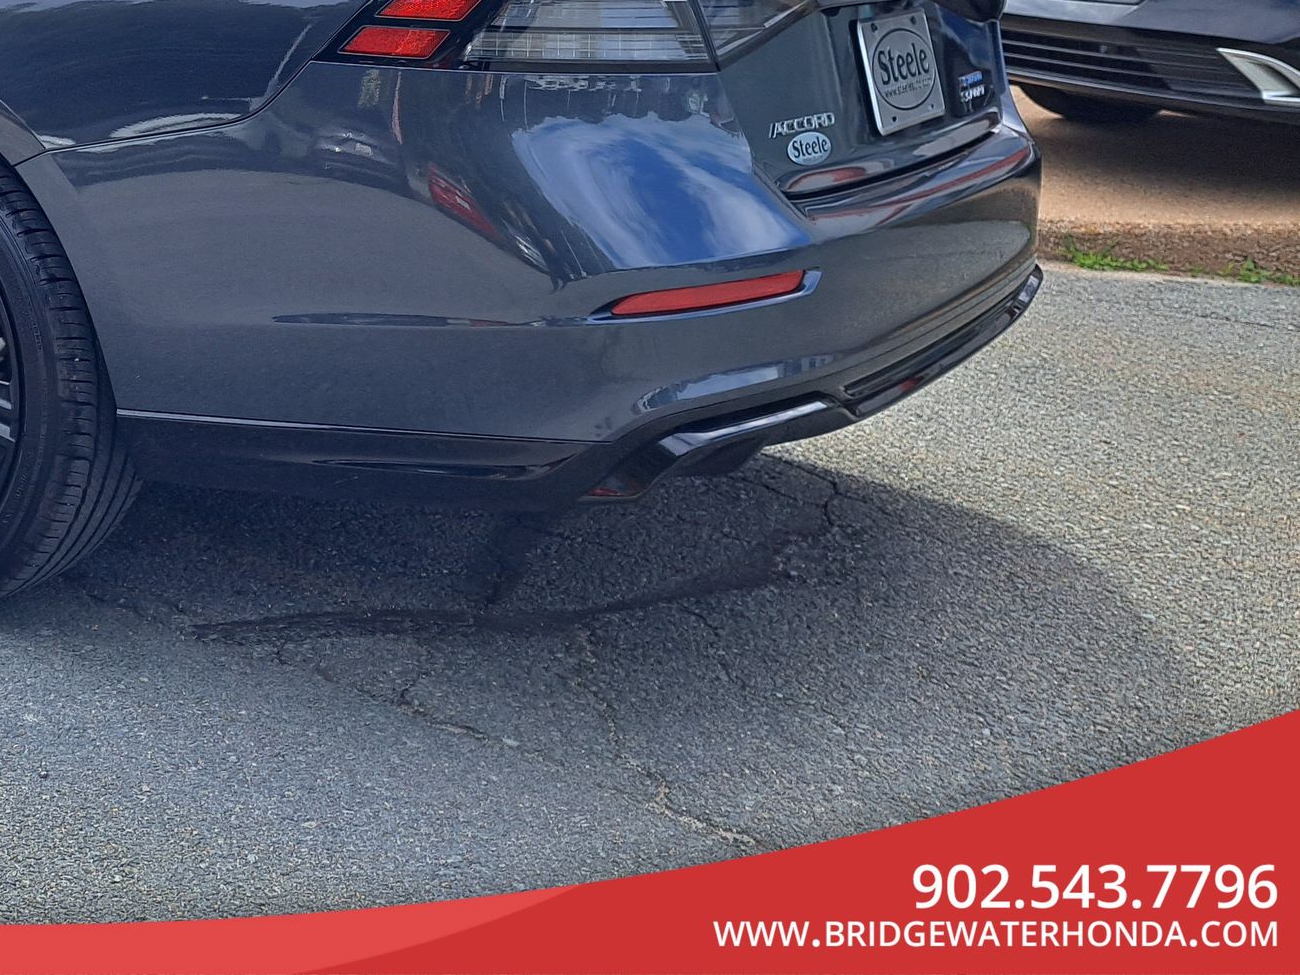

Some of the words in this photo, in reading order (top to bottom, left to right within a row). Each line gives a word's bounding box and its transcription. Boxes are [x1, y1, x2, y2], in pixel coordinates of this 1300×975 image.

[878, 42, 930, 85] Steele
[768, 112, 835, 139] ACCORD
[792, 136, 829, 158] Steele
